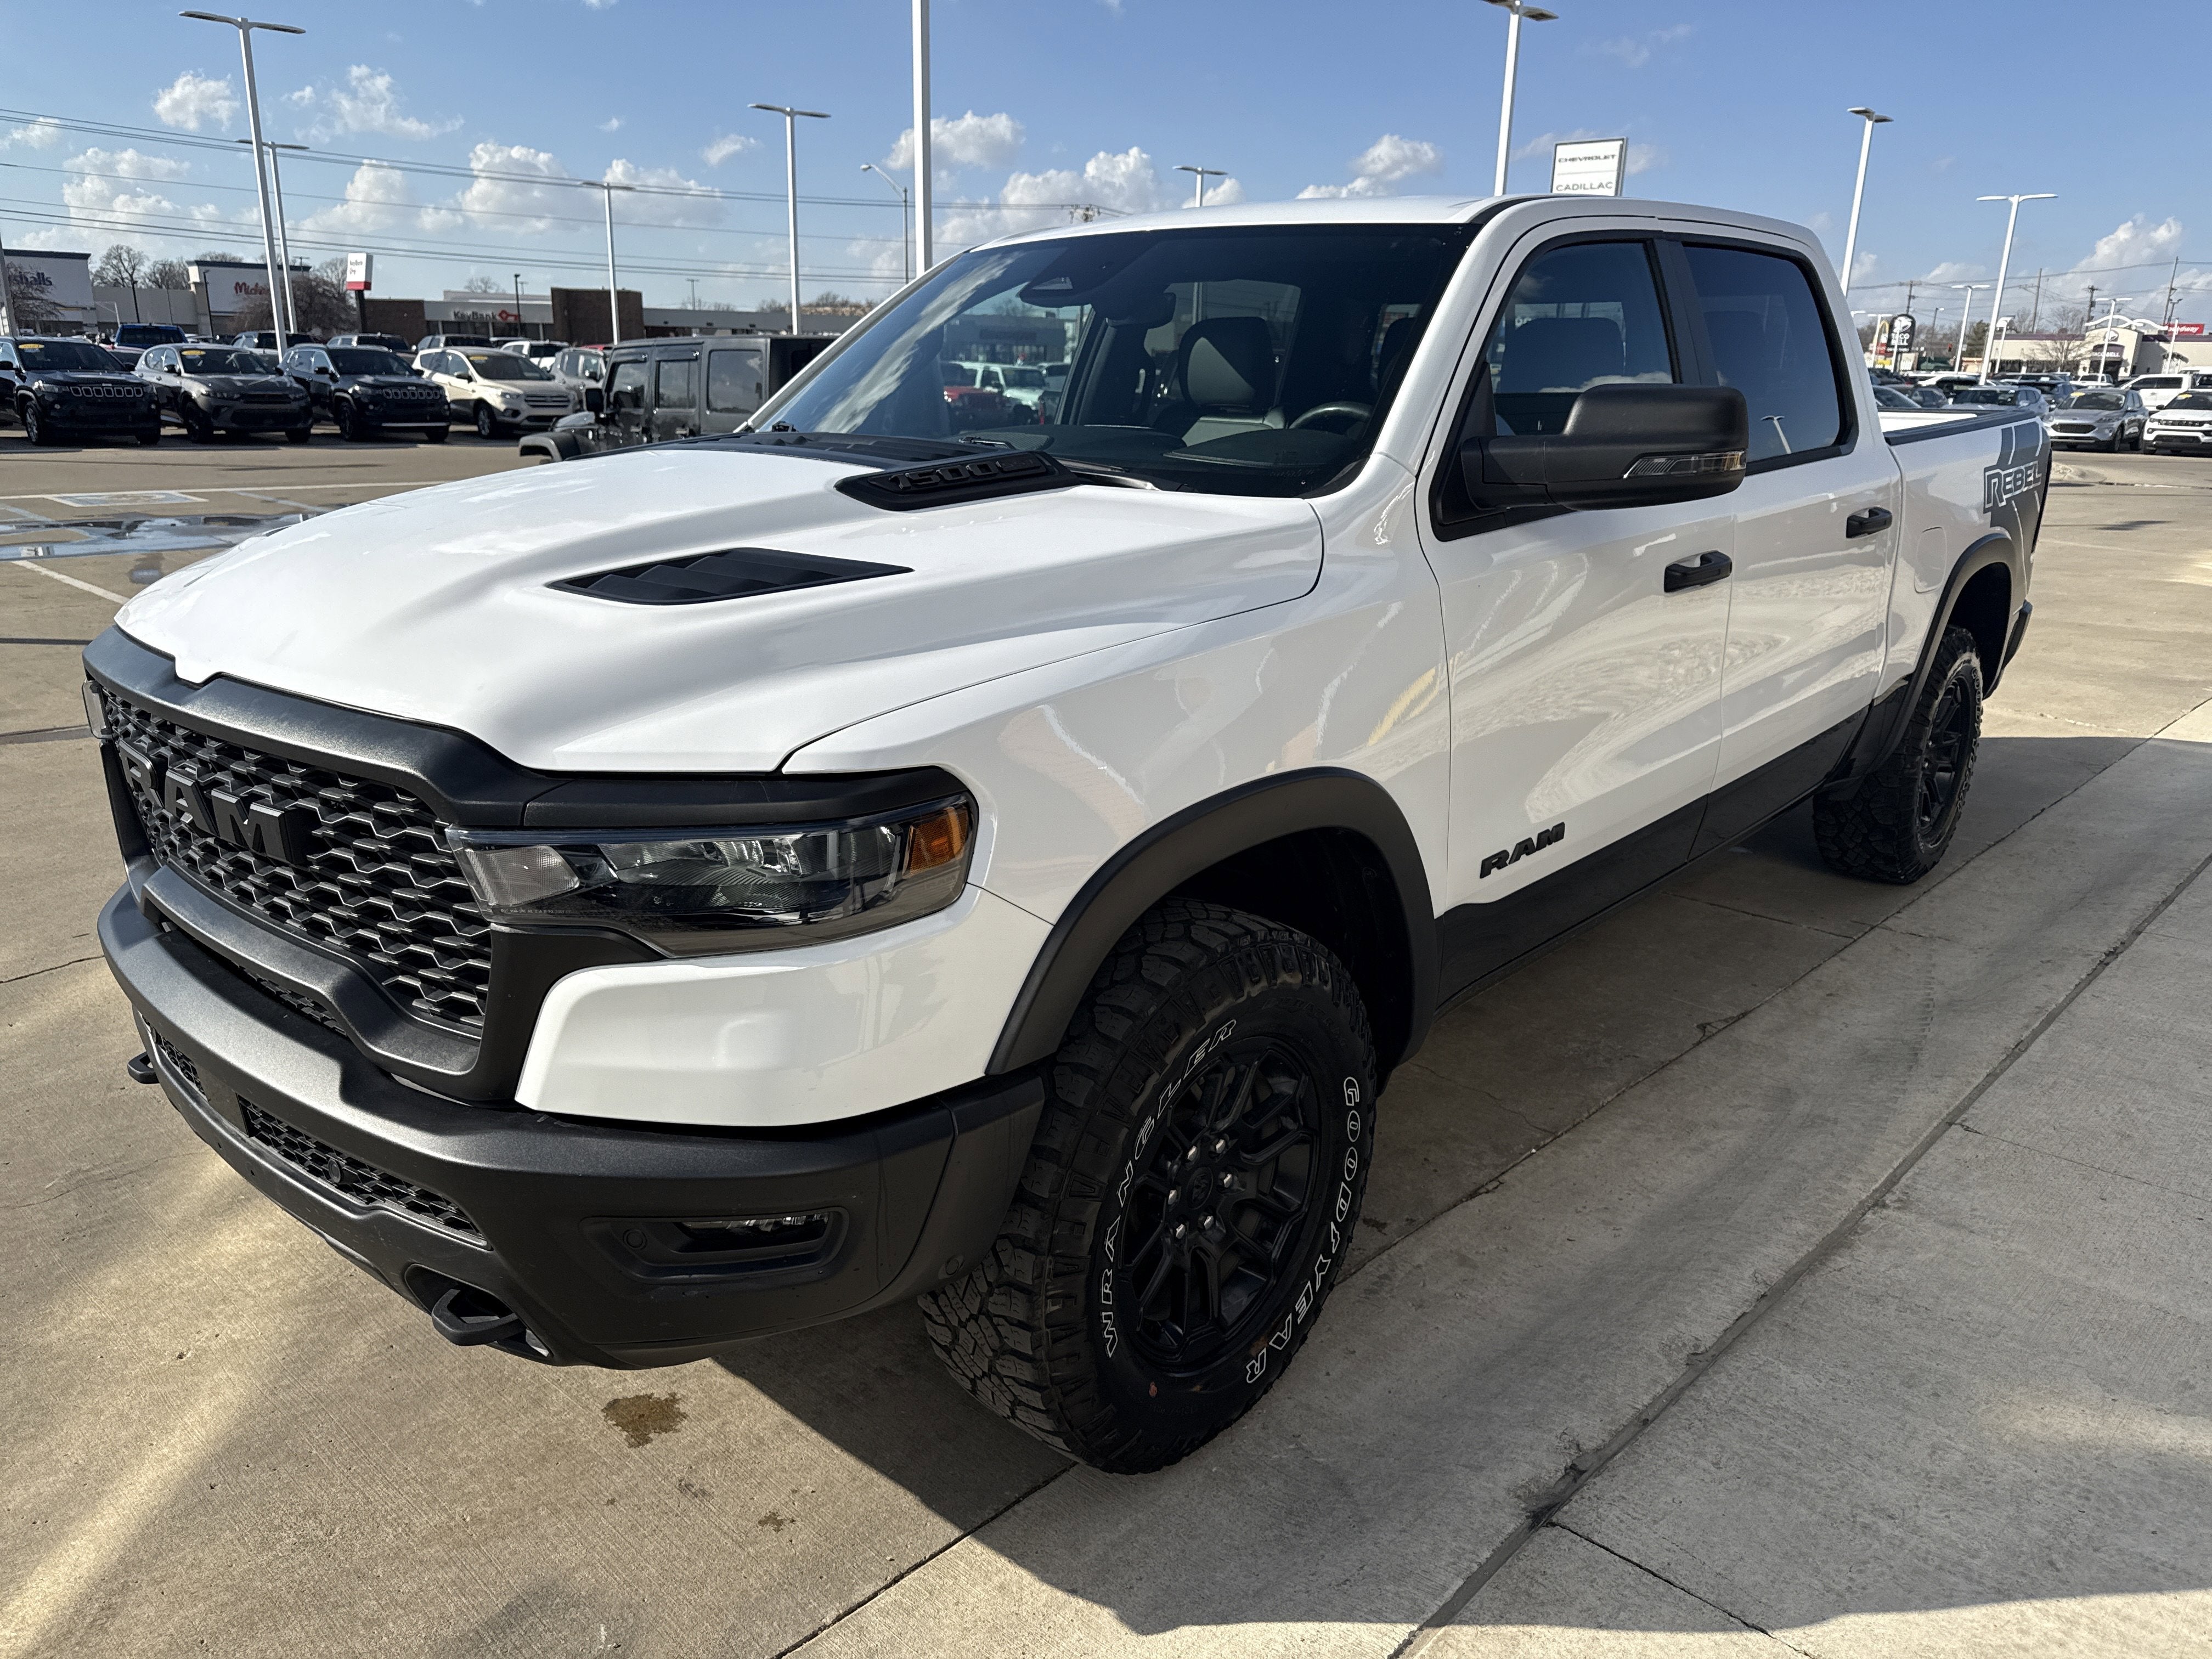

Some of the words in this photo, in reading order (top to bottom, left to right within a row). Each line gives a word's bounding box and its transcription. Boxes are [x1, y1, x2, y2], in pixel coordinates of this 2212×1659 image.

[1558, 154, 1616, 163] CHEVROLET
[1556, 182, 1613, 191] CADILLAC
[454, 310, 497, 321] KeyBank
[888, 461, 998, 490] 1500
[1985, 461, 2042, 509] REBEL
[118, 738, 291, 865] RAM
[1480, 822, 1565, 879] RAM
[1102, 1019, 1237, 1357] WRANGLER
[1246, 1076, 1361, 1383] GOODYEAR
